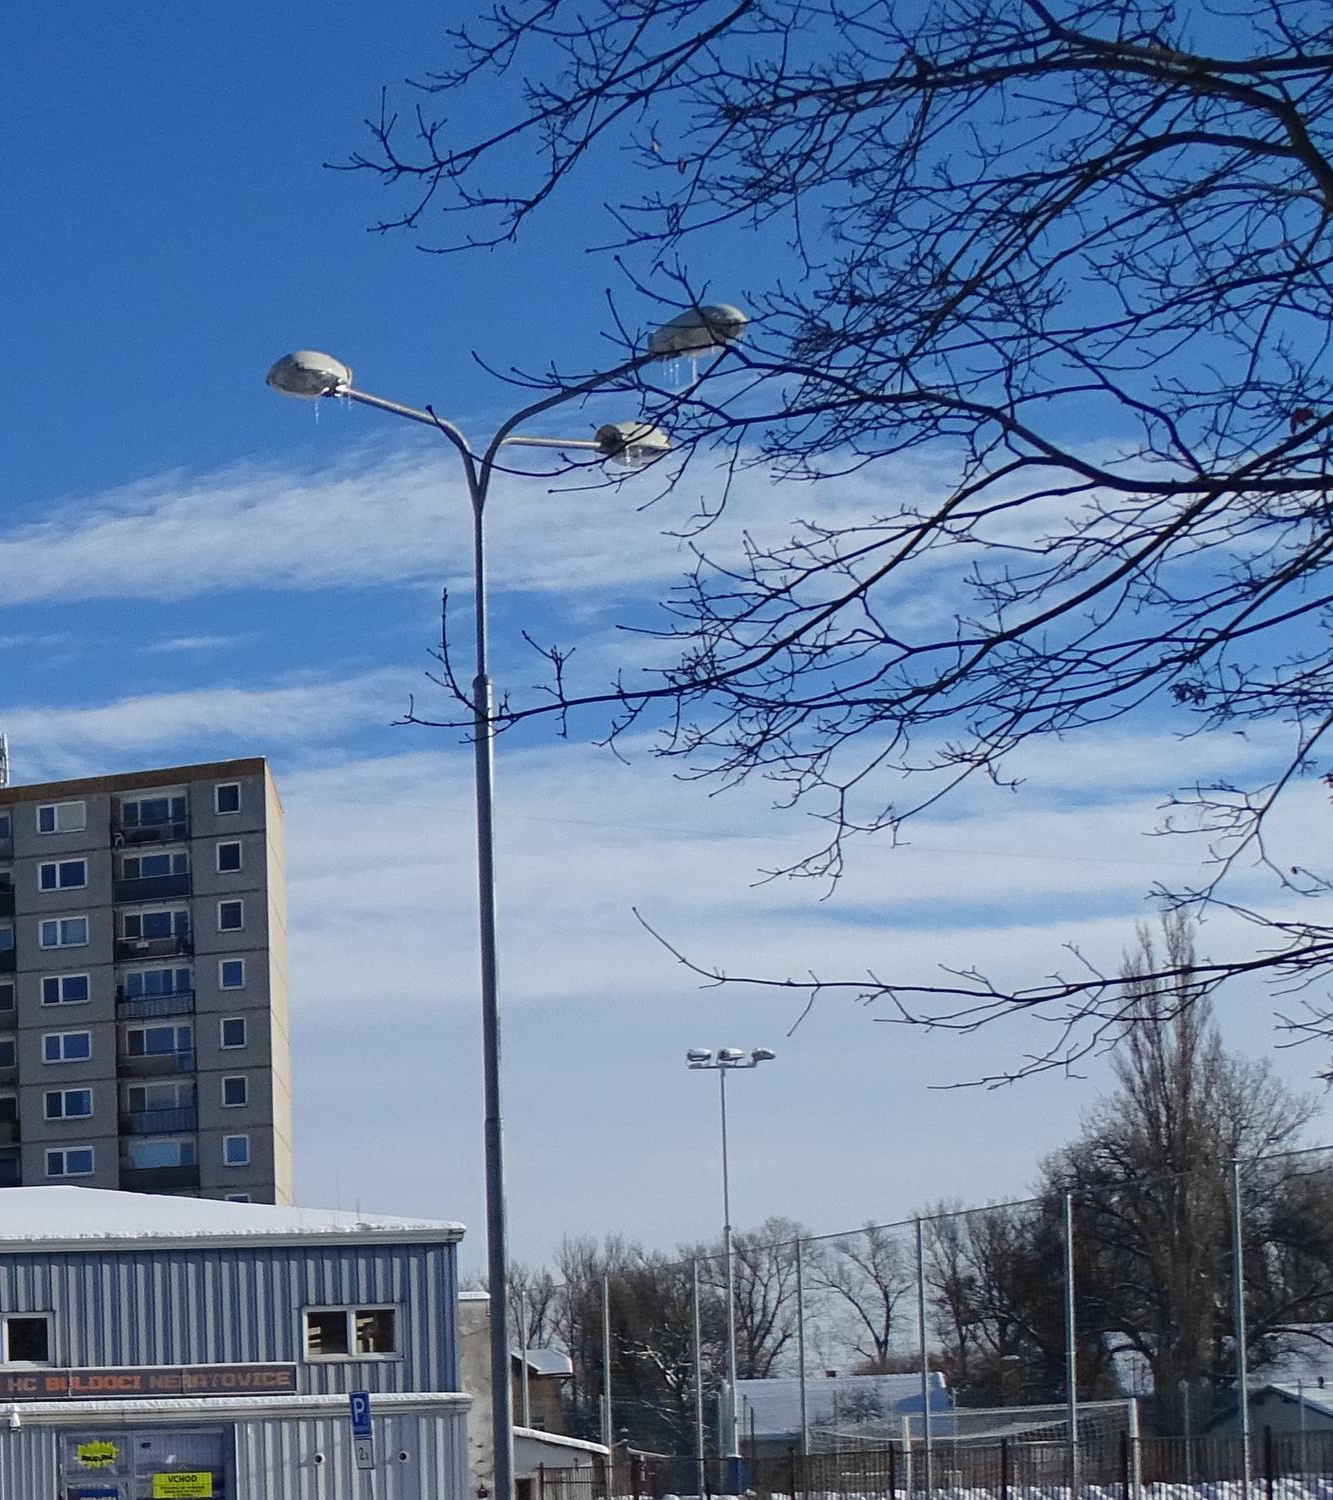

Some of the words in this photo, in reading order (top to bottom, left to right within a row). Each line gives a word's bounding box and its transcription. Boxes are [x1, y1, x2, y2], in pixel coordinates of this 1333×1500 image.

[7, 1377, 37, 1392] HC
[44, 1375, 141, 1391] BULDOCI
[353, 1397, 365, 1424] P
[167, 1474, 198, 1483] VCHOD
